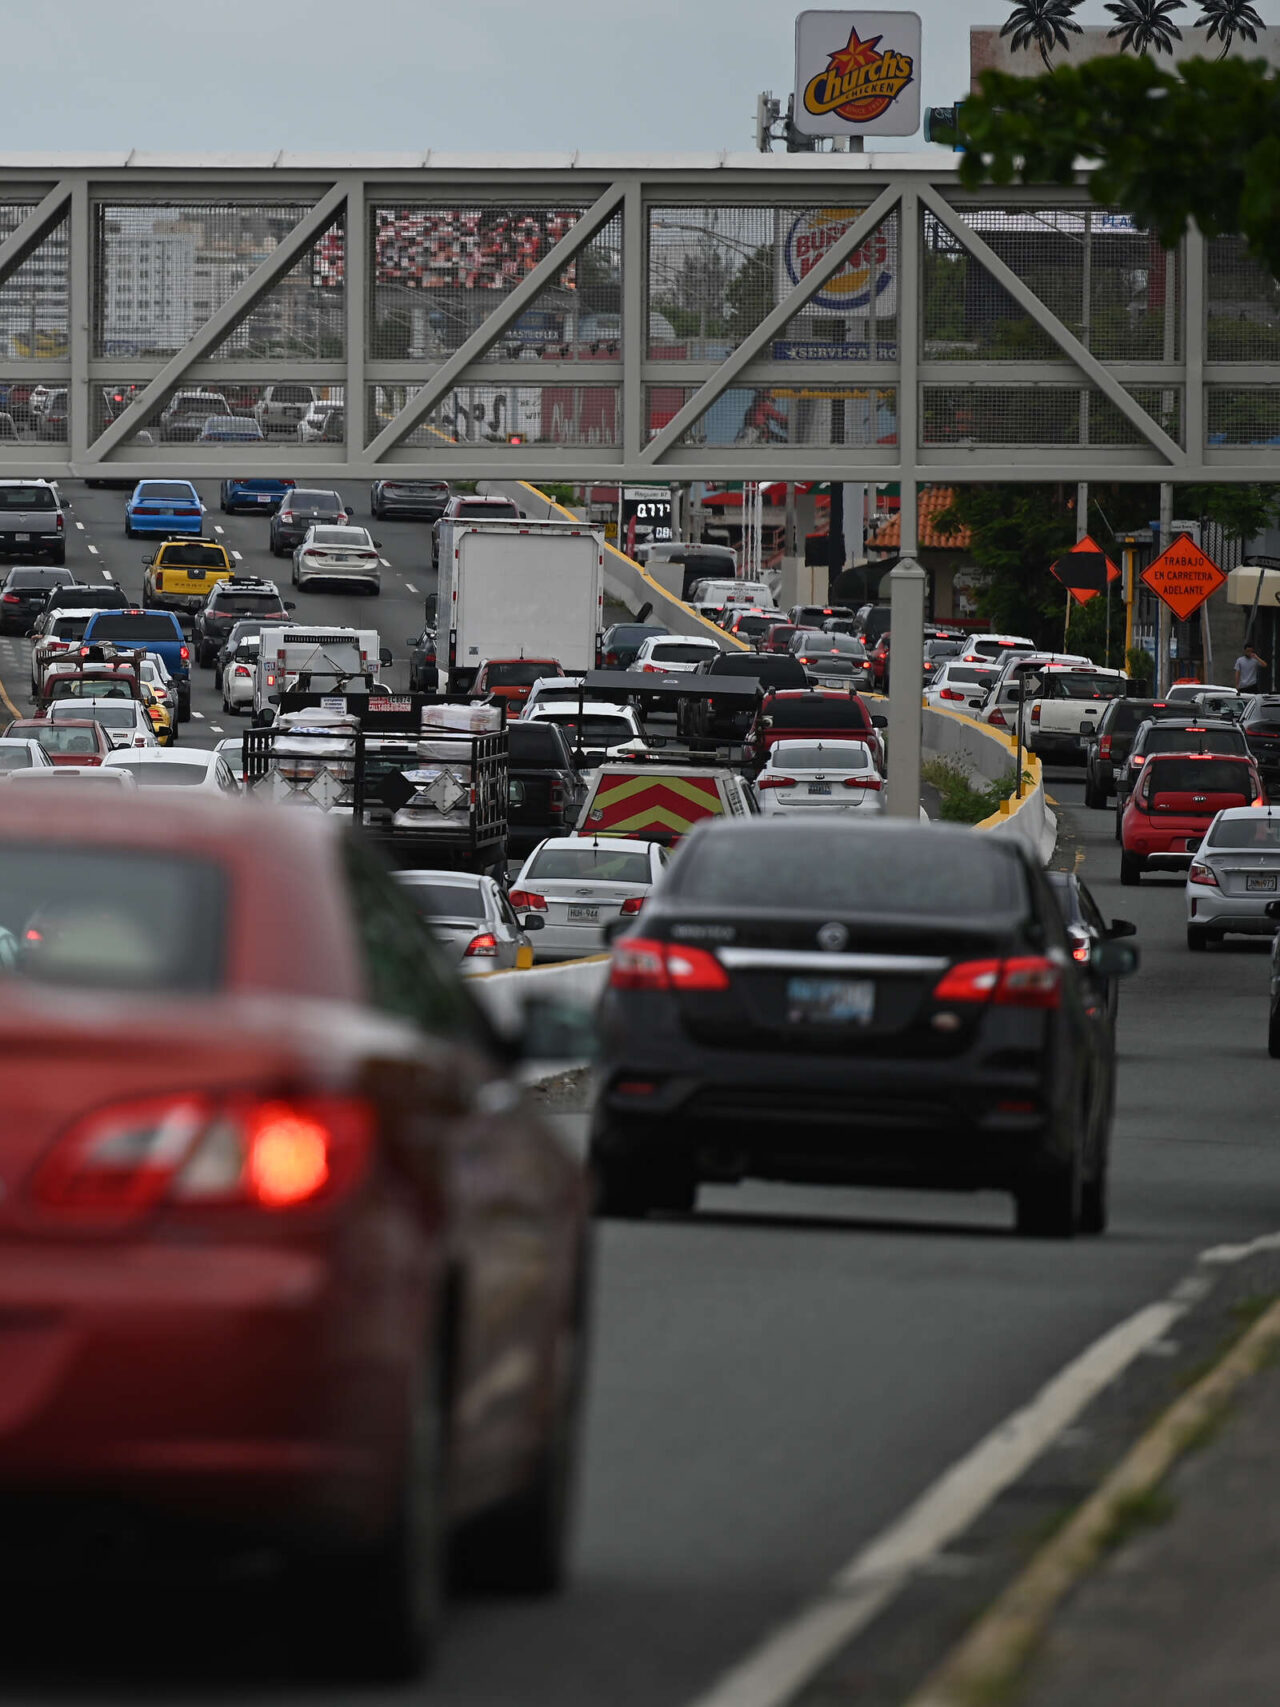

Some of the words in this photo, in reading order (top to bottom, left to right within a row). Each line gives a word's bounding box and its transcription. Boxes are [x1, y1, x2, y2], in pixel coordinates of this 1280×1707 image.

[804, 51, 913, 115] Church's
[845, 82, 894, 99] CHICKEN
[799, 346, 897, 360] SERVI-CARO
[1164, 557, 1205, 567] TRABAJO
[1154, 571, 1166, 581] EN
[1167, 571, 1213, 581] CARRETERA
[1163, 586, 1204, 596] ADELANTE
